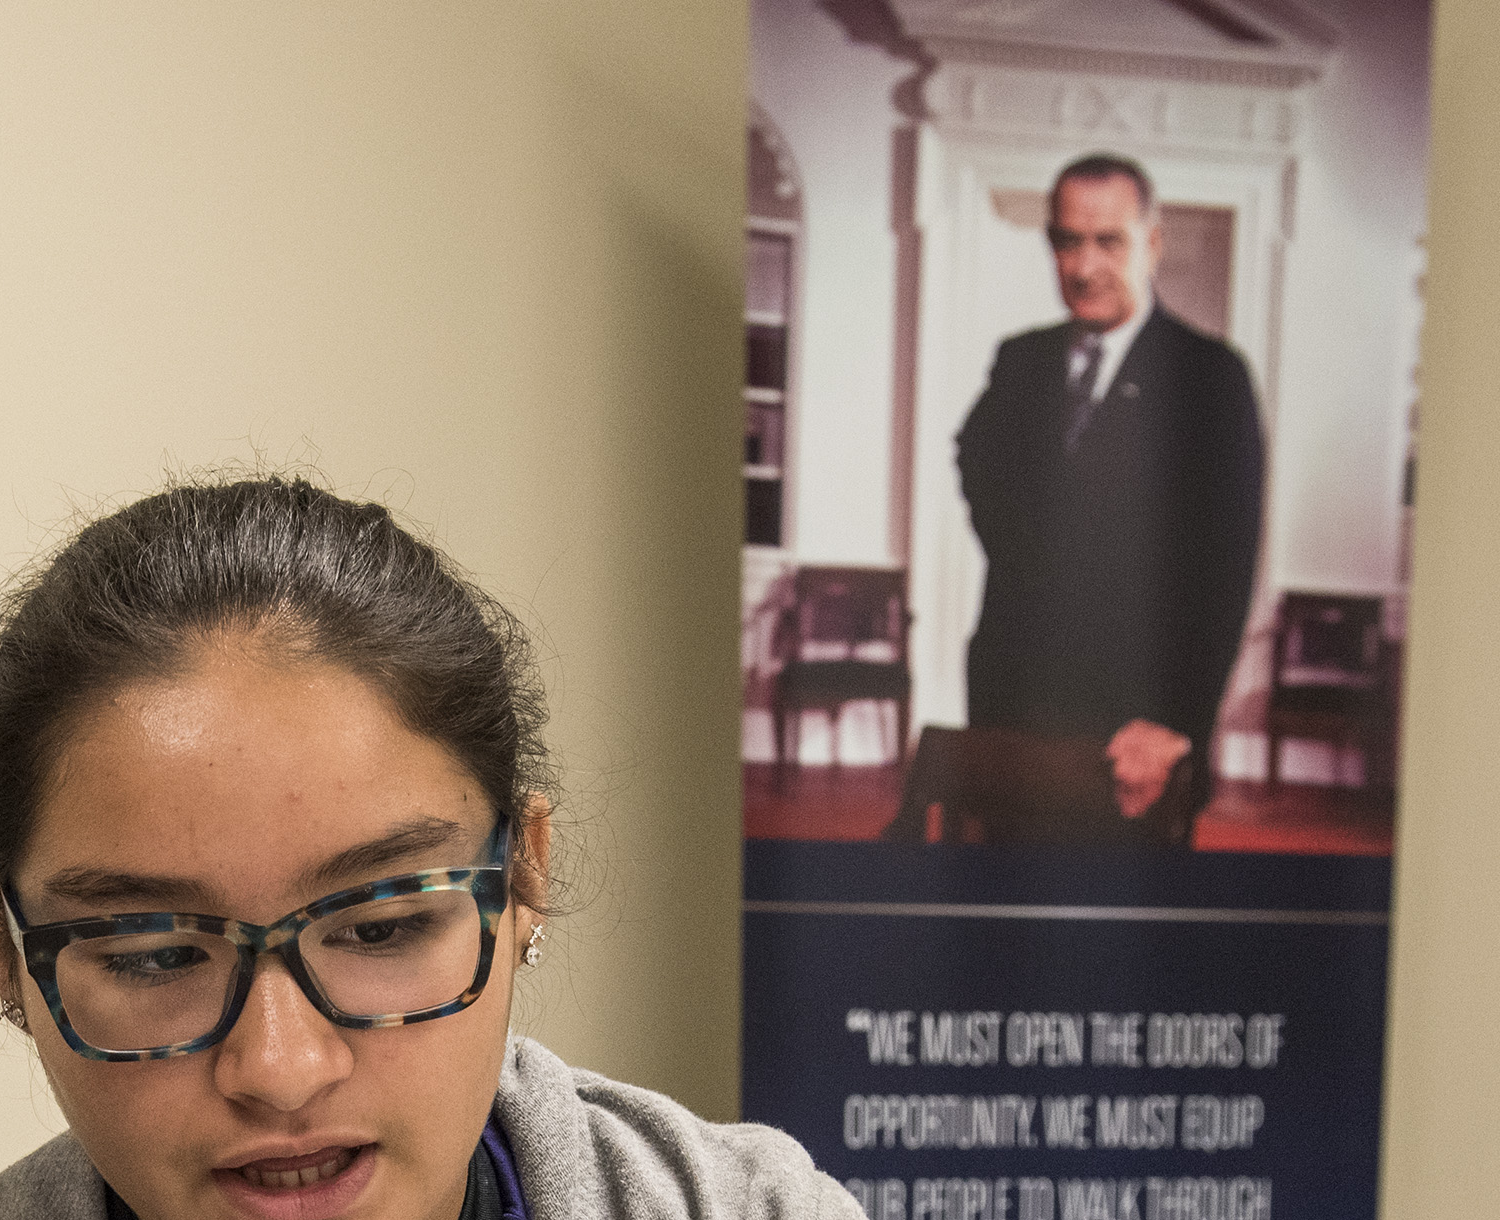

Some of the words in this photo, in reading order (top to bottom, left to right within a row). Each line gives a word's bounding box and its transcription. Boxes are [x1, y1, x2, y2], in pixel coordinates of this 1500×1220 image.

[920, 1010, 1001, 1067] MUST
[1006, 1011, 1084, 1067] OPEN
[1089, 1012, 1144, 1068] THE
[1147, 1012, 1244, 1069] DOORS
[1245, 1013, 1284, 1069] OF
[1042, 1095, 1091, 1149] WE
[1096, 1095, 1177, 1149] MUST
[1181, 1095, 1265, 1152] EQUIP
